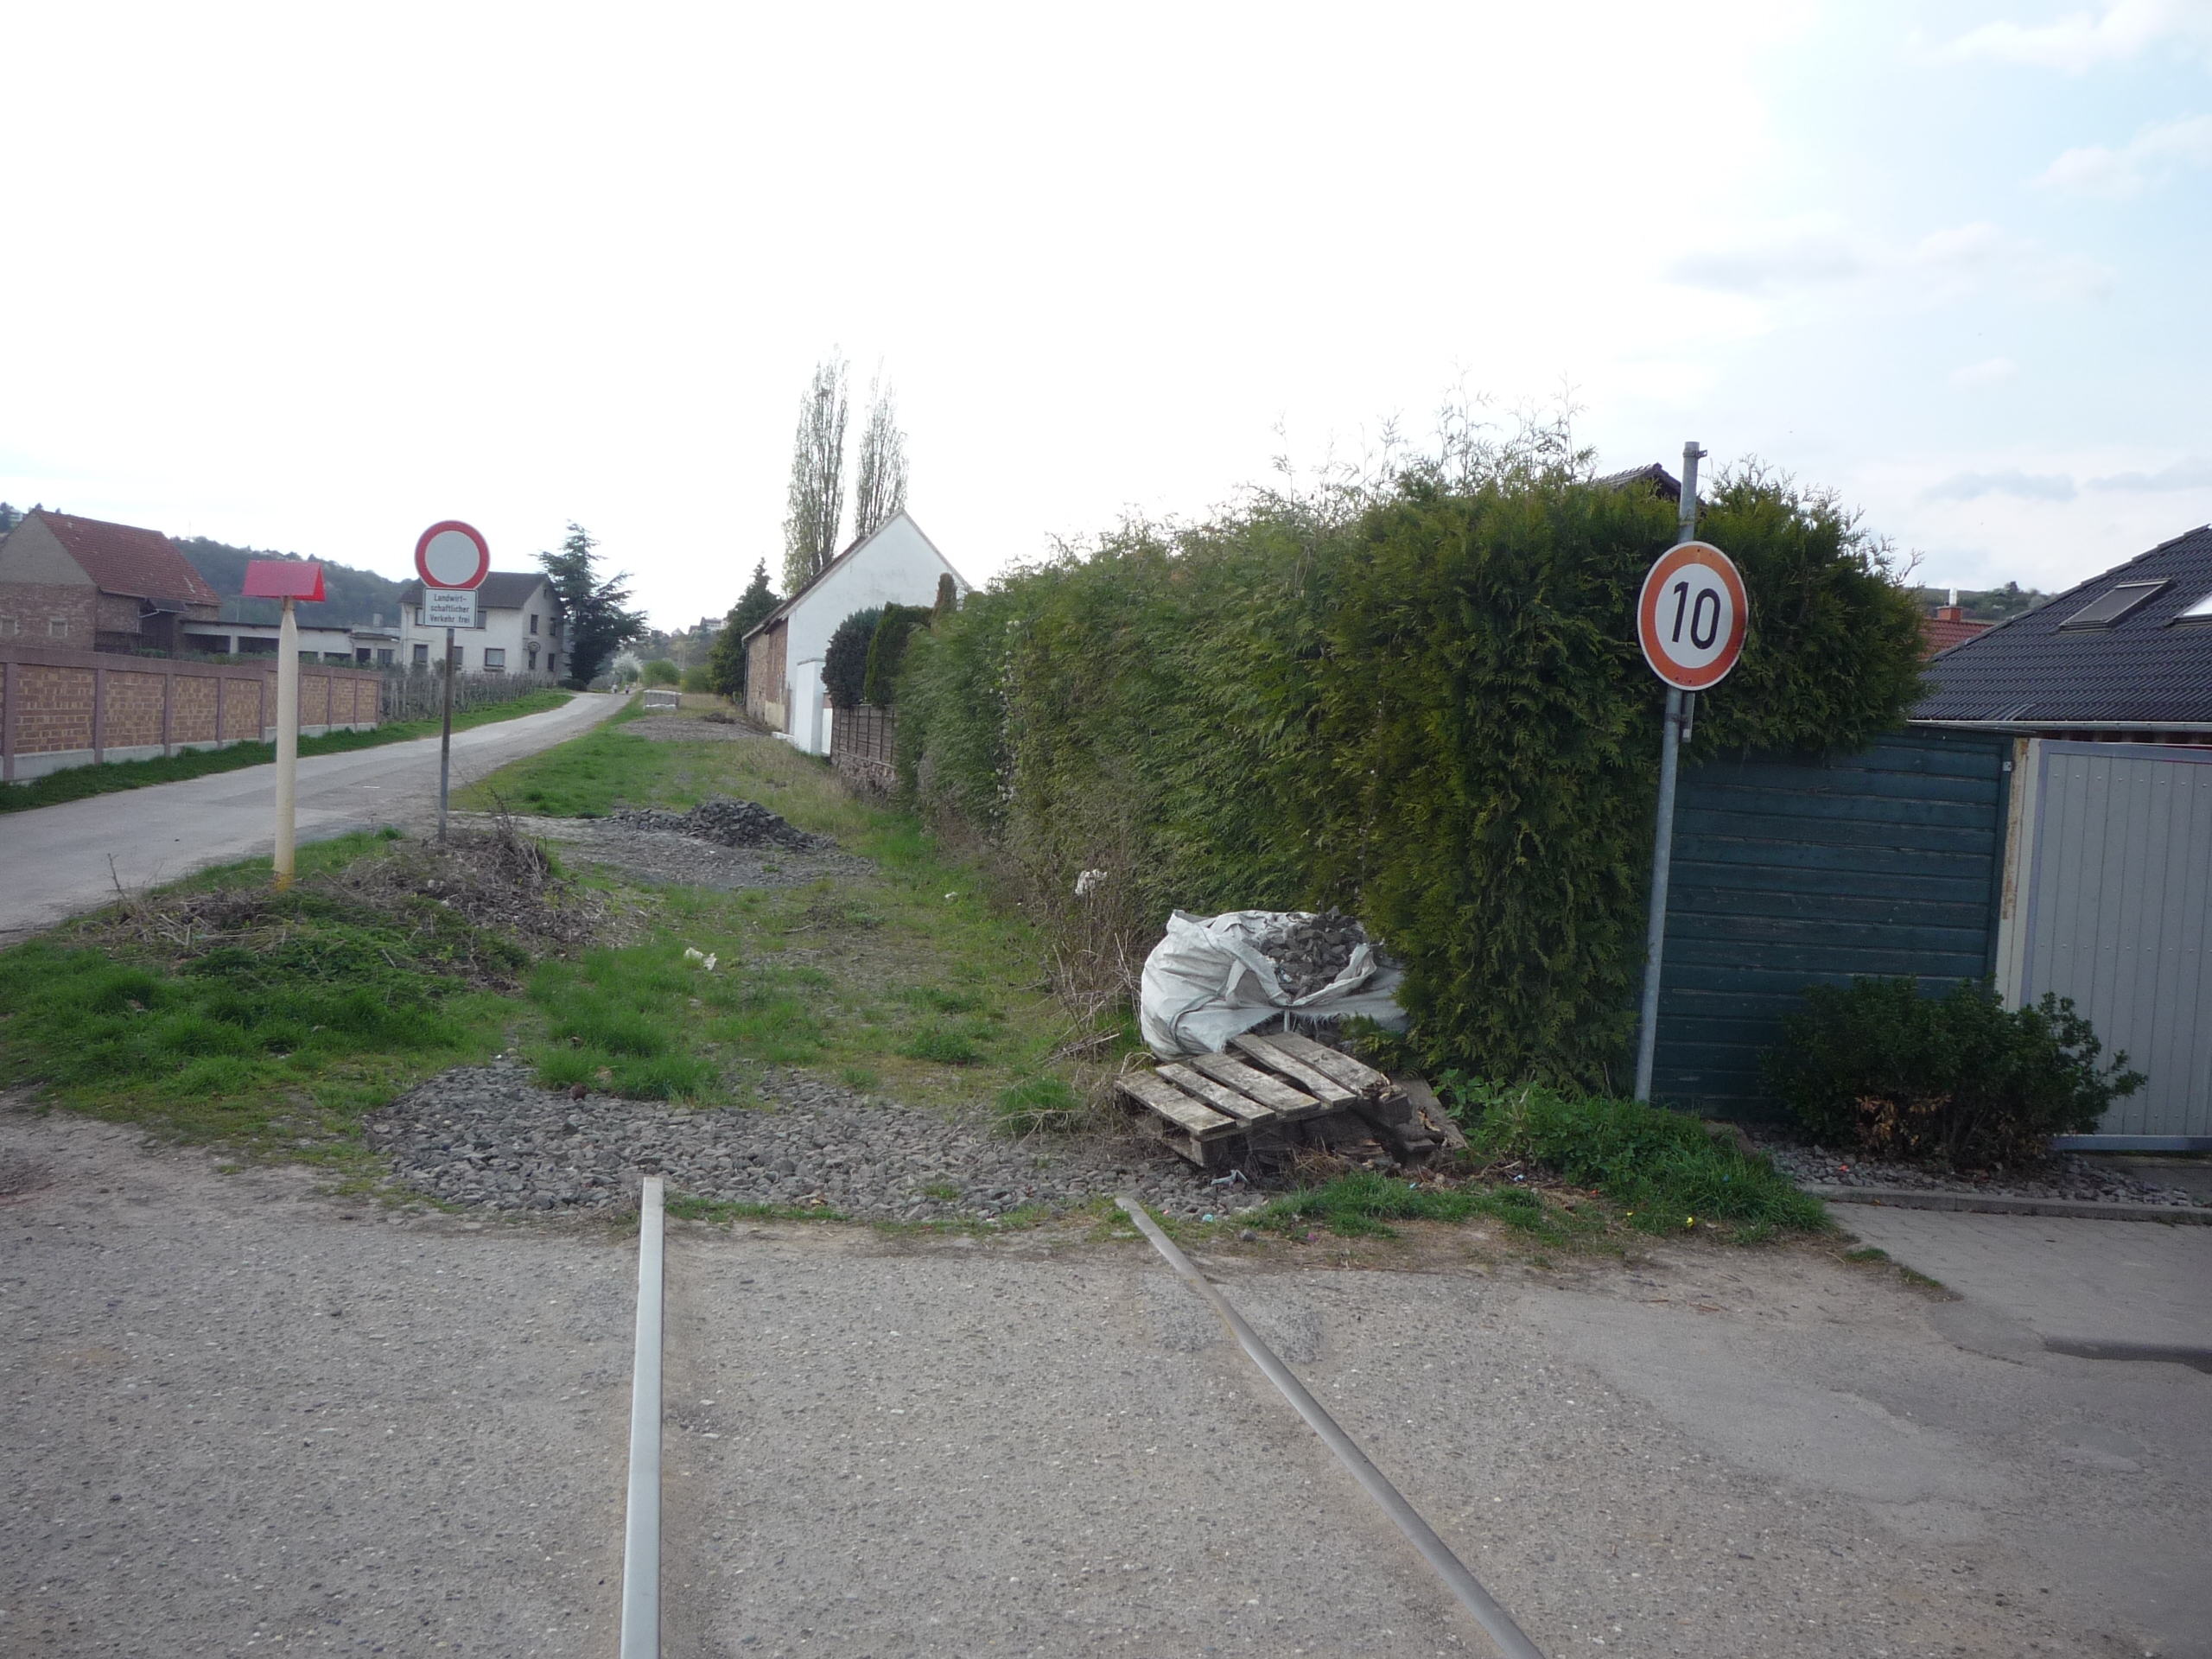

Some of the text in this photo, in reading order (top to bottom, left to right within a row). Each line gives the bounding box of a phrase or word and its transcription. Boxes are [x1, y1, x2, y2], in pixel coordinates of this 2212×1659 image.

[434, 594, 467, 602] Landwirt-
[430, 604, 470, 613] schaftlicher
[429, 614, 470, 624] Verkehr frei
[1672, 581, 1721, 650] 10
